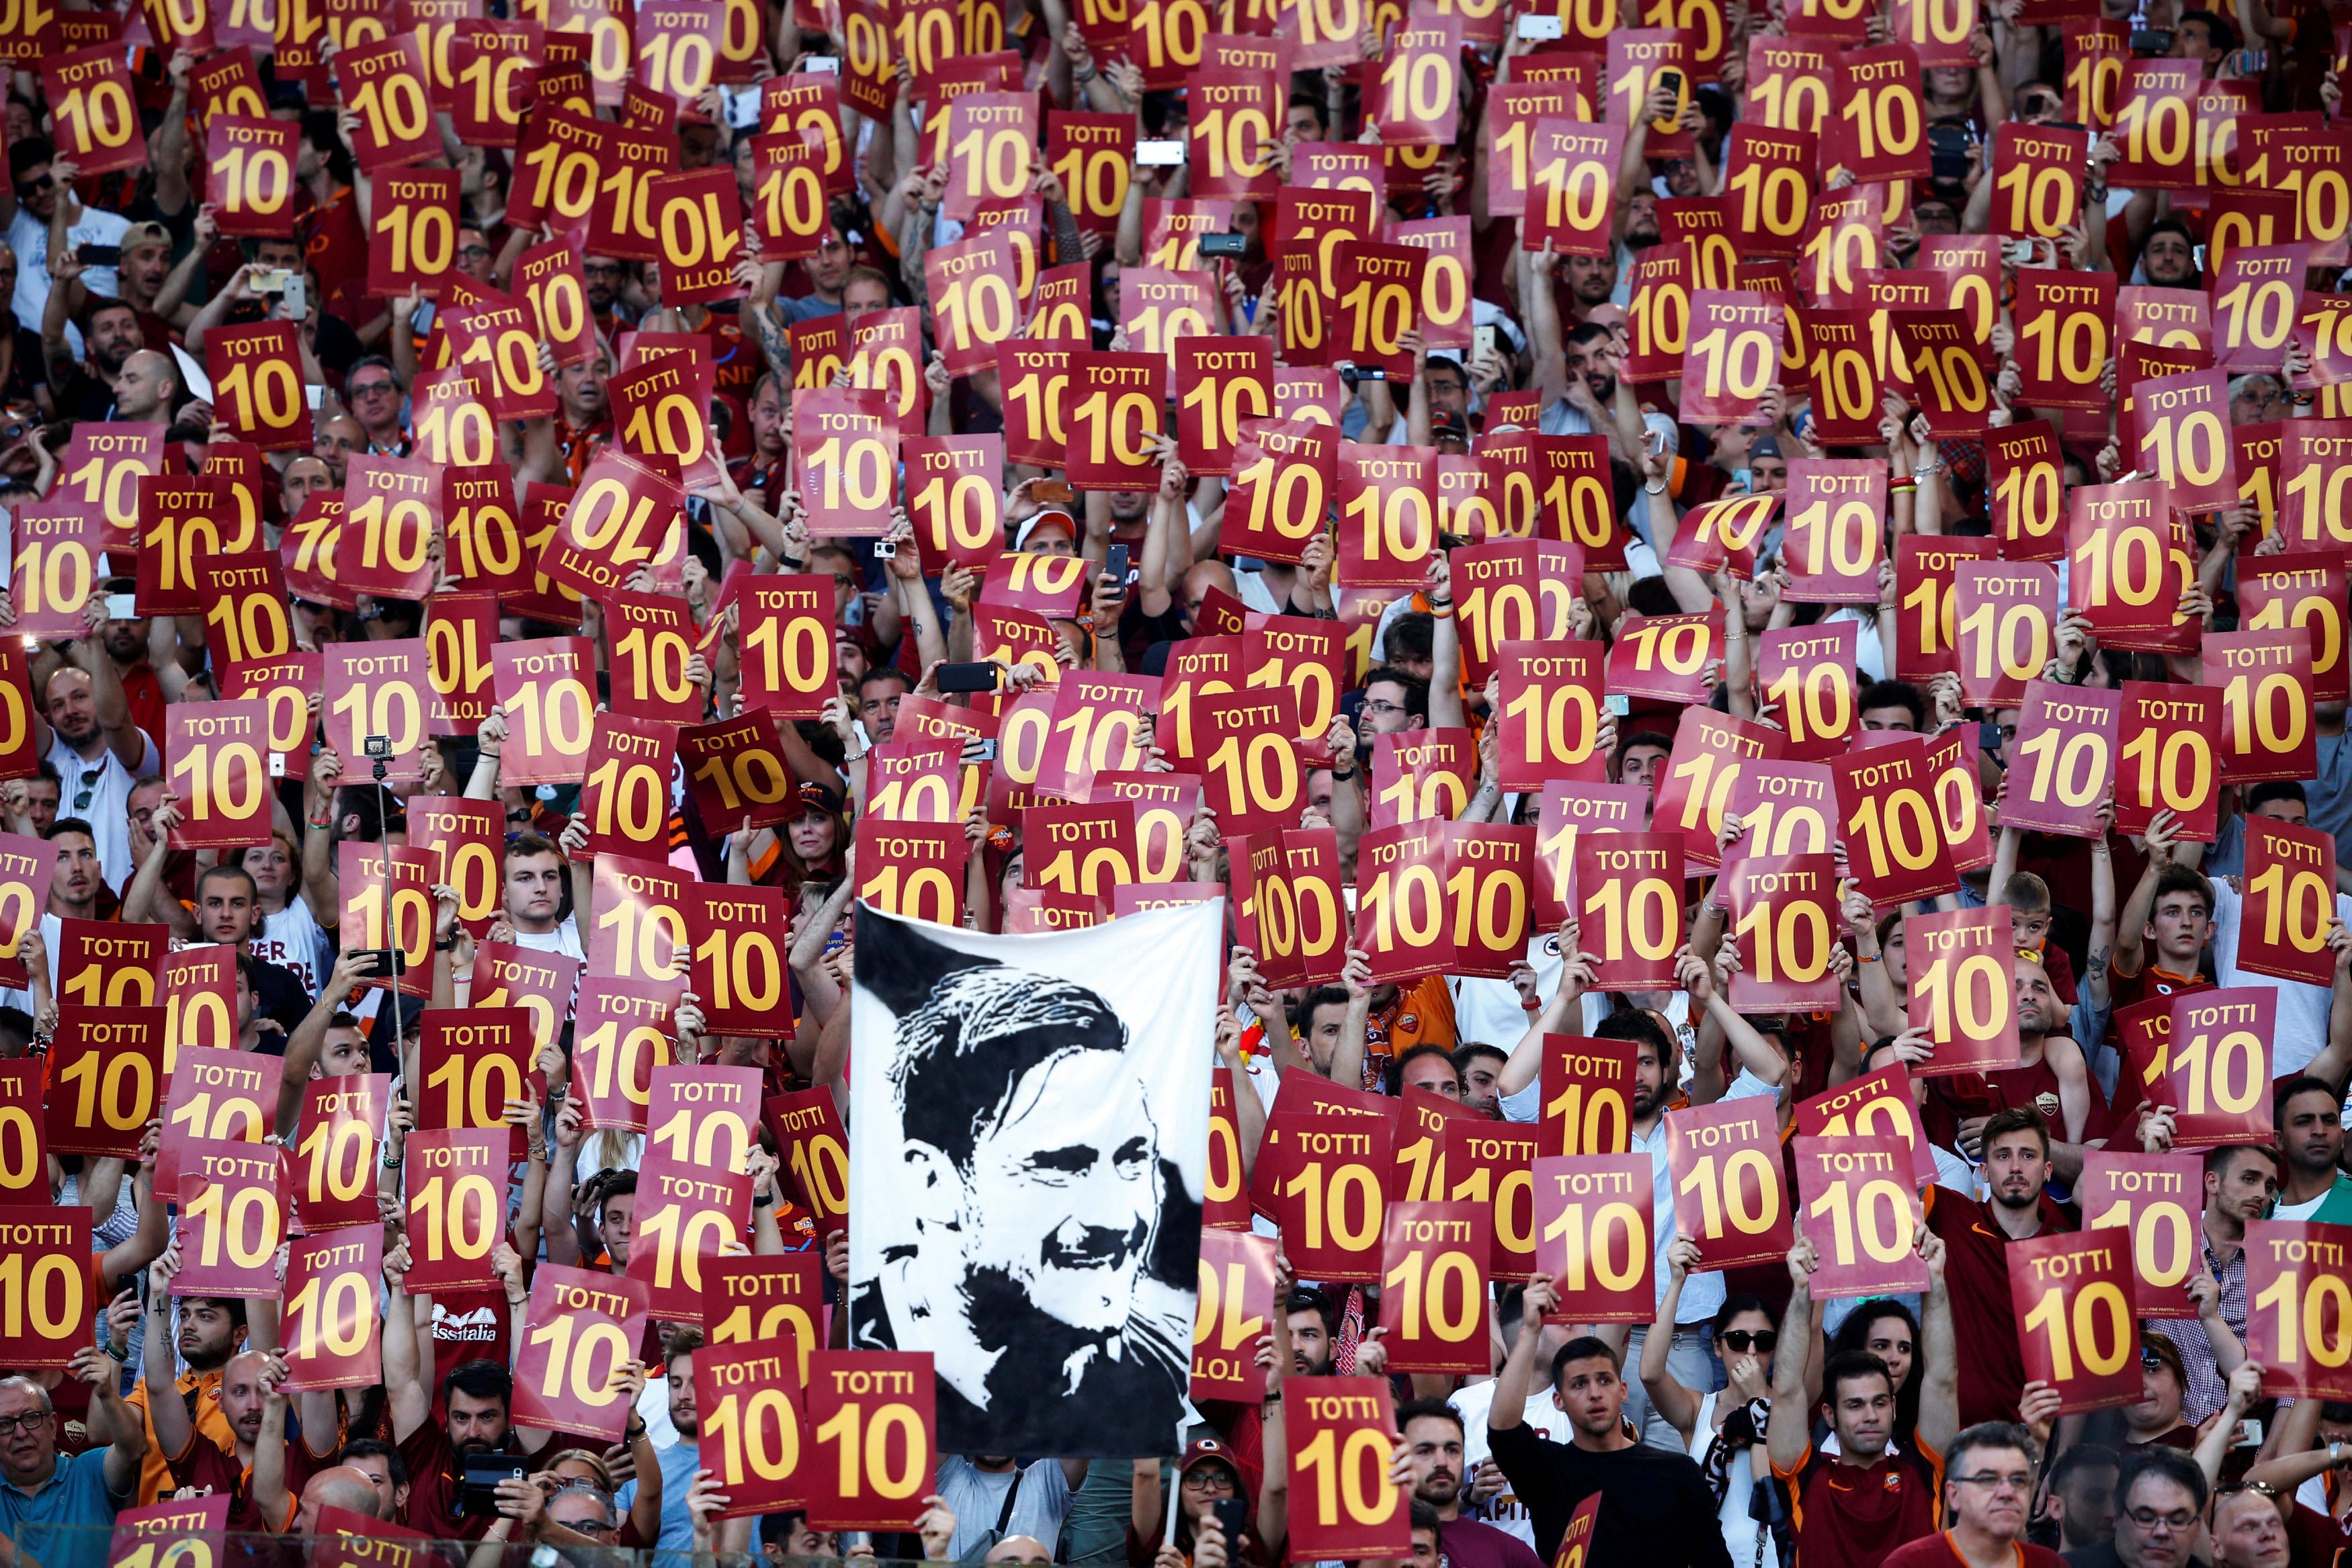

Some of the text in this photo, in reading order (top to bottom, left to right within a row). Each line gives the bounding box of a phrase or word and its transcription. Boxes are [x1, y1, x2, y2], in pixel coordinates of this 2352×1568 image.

[653, 12, 709, 28] TOTTI
[1393, 32, 1445, 48] TOTTI
[58, 58, 114, 85] TOTTI
[350, 50, 407, 79] TOTTI
[640, 33, 714, 97] 10
[1381, 53, 1452, 122] 10
[1849, 60, 1904, 82] TOTTI
[2134, 73, 2186, 89] TOTTI
[56, 81, 132, 156] 10
[226, 127, 284, 144] TOTTI
[351, 73, 429, 147] 10
[548, 119, 602, 150] TOTTI
[966, 106, 1023, 123] TOTTI
[1064, 126, 1120, 142] TOTTI
[1843, 85, 1919, 158] 10
[2115, 95, 2189, 165] 10
[953, 129, 1030, 198] 10
[1551, 134, 1608, 155] TOTTI
[1745, 139, 1800, 161] TOTTI
[212, 147, 288, 214] 10
[389, 182, 446, 199] TOTTI
[526, 142, 600, 217] 10
[1054, 150, 1128, 218] 10
[1534, 158, 1609, 230] 10
[1730, 163, 1807, 236] 10
[377, 205, 453, 274] 10
[661, 193, 739, 267] 10
[939, 250, 997, 277] TOTTI
[2236, 258, 2291, 275] TOTTI
[935, 274, 1014, 350] 10
[1708, 305, 1769, 324] TOTTI
[2035, 285, 2098, 304] TOTTI
[2217, 281, 2294, 349] 10
[222, 335, 283, 357] TOTTI
[1691, 329, 1773, 400] 10
[2023, 310, 2106, 385] 10
[218, 359, 300, 431] 10
[818, 413, 882, 432] TOTTI
[1257, 430, 1320, 458] TOTTI
[1999, 436, 2047, 460] TOTTI
[366, 471, 429, 494] TOTTI
[807, 437, 891, 510] 10
[921, 450, 984, 470] TOTTI
[1357, 460, 1421, 479] TOTTI
[1547, 451, 1594, 468] TOTTI
[1806, 476, 1870, 493] TOTTI
[571, 478, 656, 566] 10
[914, 475, 996, 552] 10
[1237, 458, 1322, 539] 10
[1346, 486, 1433, 562] 10
[1544, 476, 1611, 548] 10
[1997, 462, 2058, 540] 10
[2088, 499, 2150, 521] TOTTI
[23, 517, 83, 535] TOTTI
[349, 496, 432, 573] 10
[1792, 501, 1878, 578] 10
[14, 541, 91, 616] 10
[1974, 577, 2040, 596] TOTTI
[2076, 526, 2162, 607] 10
[620, 605, 677, 625] TOTTI
[756, 591, 816, 609] TOTTI
[1644, 615, 1710, 625] TOTTI
[511, 653, 579, 675] TOTTI
[616, 628, 694, 703] 10
[747, 617, 829, 692] 10
[1518, 658, 1586, 676] TOTTI
[1624, 623, 1711, 677] 10
[1960, 603, 2048, 681] 10
[2222, 646, 2292, 667] TOTTI
[184, 716, 250, 736] TOTTI
[505, 679, 593, 757] 10
[1212, 705, 1279, 729] TOTTI
[1507, 685, 1597, 764] 10
[2044, 701, 2109, 725] TOTTI
[2138, 699, 2203, 722] TOTTI
[2224, 673, 2306, 754] 10
[607, 731, 659, 758] TOTTI
[2020, 728, 2107, 808] 10
[2122, 728, 2211, 812] 10
[173, 742, 263, 821] 10
[587, 758, 663, 841] 10
[1208, 733, 1298, 816] 10
[1850, 759, 1912, 789] TOTTI
[1372, 837, 1429, 865] TOTTI
[1596, 851, 1666, 870] TOTTI
[1848, 789, 1939, 879] 10
[2263, 835, 2321, 867] TOTTI
[1361, 865, 1442, 954] 10
[1747, 872, 1816, 893] TOTTI
[2251, 864, 2332, 953] 10
[705, 901, 765, 923] TOTTI
[1585, 878, 1679, 962] 10
[1924, 925, 1993, 951] TOTTI
[1736, 900, 1830, 984] 10
[697, 929, 780, 1012] 10
[1915, 955, 2009, 1044] 10
[2188, 1004, 2255, 1028] TOTTI
[79, 1023, 147, 1043] TOTTI
[61, 1051, 154, 1131] 10
[2173, 1031, 2264, 1115] 10
[317, 1092, 372, 1113] TOTTI
[296, 1120, 374, 1202] 10
[423, 1146, 488, 1168] TOTTI
[1298, 1133, 1370, 1154] TOTTI
[1686, 1120, 1759, 1149] TOTTI
[202, 1156, 277, 1181] TOTTI
[1554, 1172, 1632, 1194] TOTTI
[1817, 1153, 1893, 1172] TOTTI
[411, 1175, 499, 1264] 10
[1287, 1162, 1382, 1251] 10
[1679, 1149, 1779, 1240] 10
[185, 1184, 280, 1268] 10
[1404, 1221, 1470, 1242] TOTTI
[1544, 1203, 1646, 1293] 10
[1810, 1180, 1915, 1266] 10
[304, 1244, 364, 1267] TOTTI
[2031, 1249, 2111, 1281] TOTTI
[287, 1272, 370, 1360] 10
[554, 1284, 628, 1317] TOTTI
[1386, 1251, 1480, 1342] 10
[431, 1321, 496, 1342] Assitalia
[2025, 1282, 2130, 1383] 10
[530, 1315, 630, 1406] 10
[711, 1358, 780, 1387] TOTTI
[832, 1371, 913, 1393] TOTTI
[1306, 1397, 1379, 1420] TOTTI
[704, 1389, 799, 1485] 10
[817, 1403, 926, 1499] 10
[1296, 1429, 1400, 1525] 10
